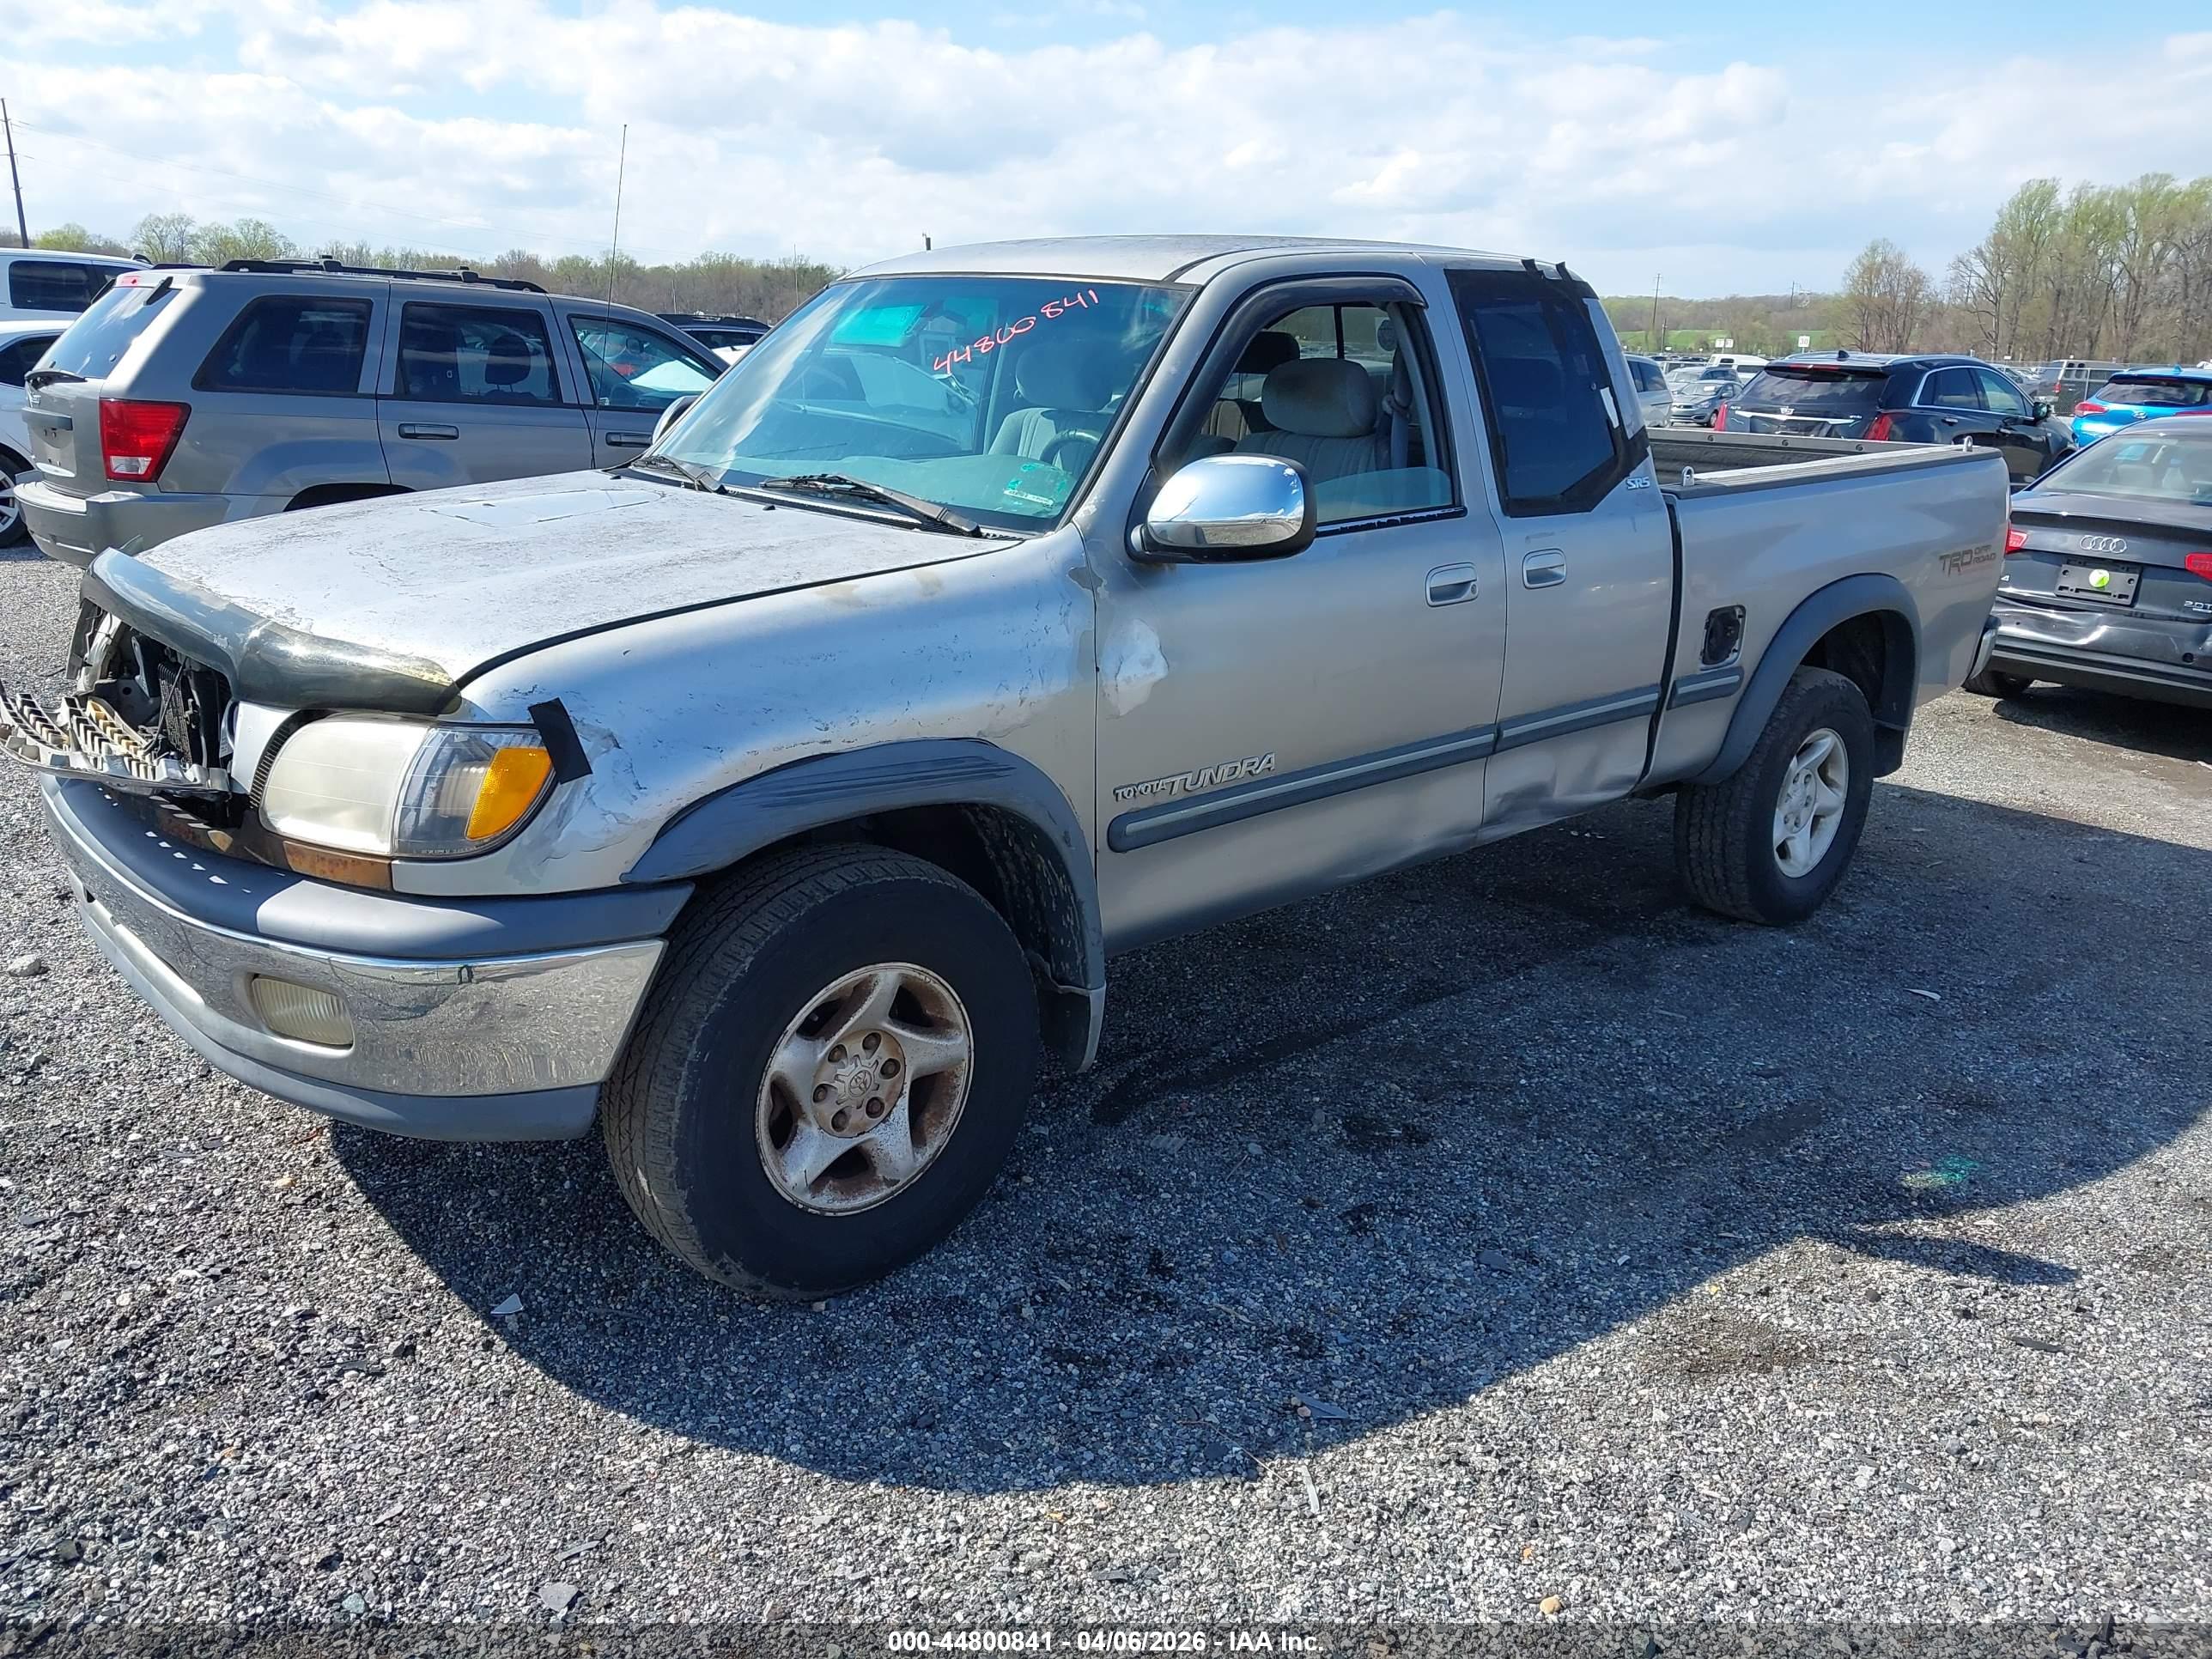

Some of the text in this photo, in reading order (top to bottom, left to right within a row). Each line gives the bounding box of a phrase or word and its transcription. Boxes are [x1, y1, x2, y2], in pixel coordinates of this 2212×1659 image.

[1939, 549, 1973, 577] TRD
[1114, 752, 1276, 801] TOYOTA TUNDRA
